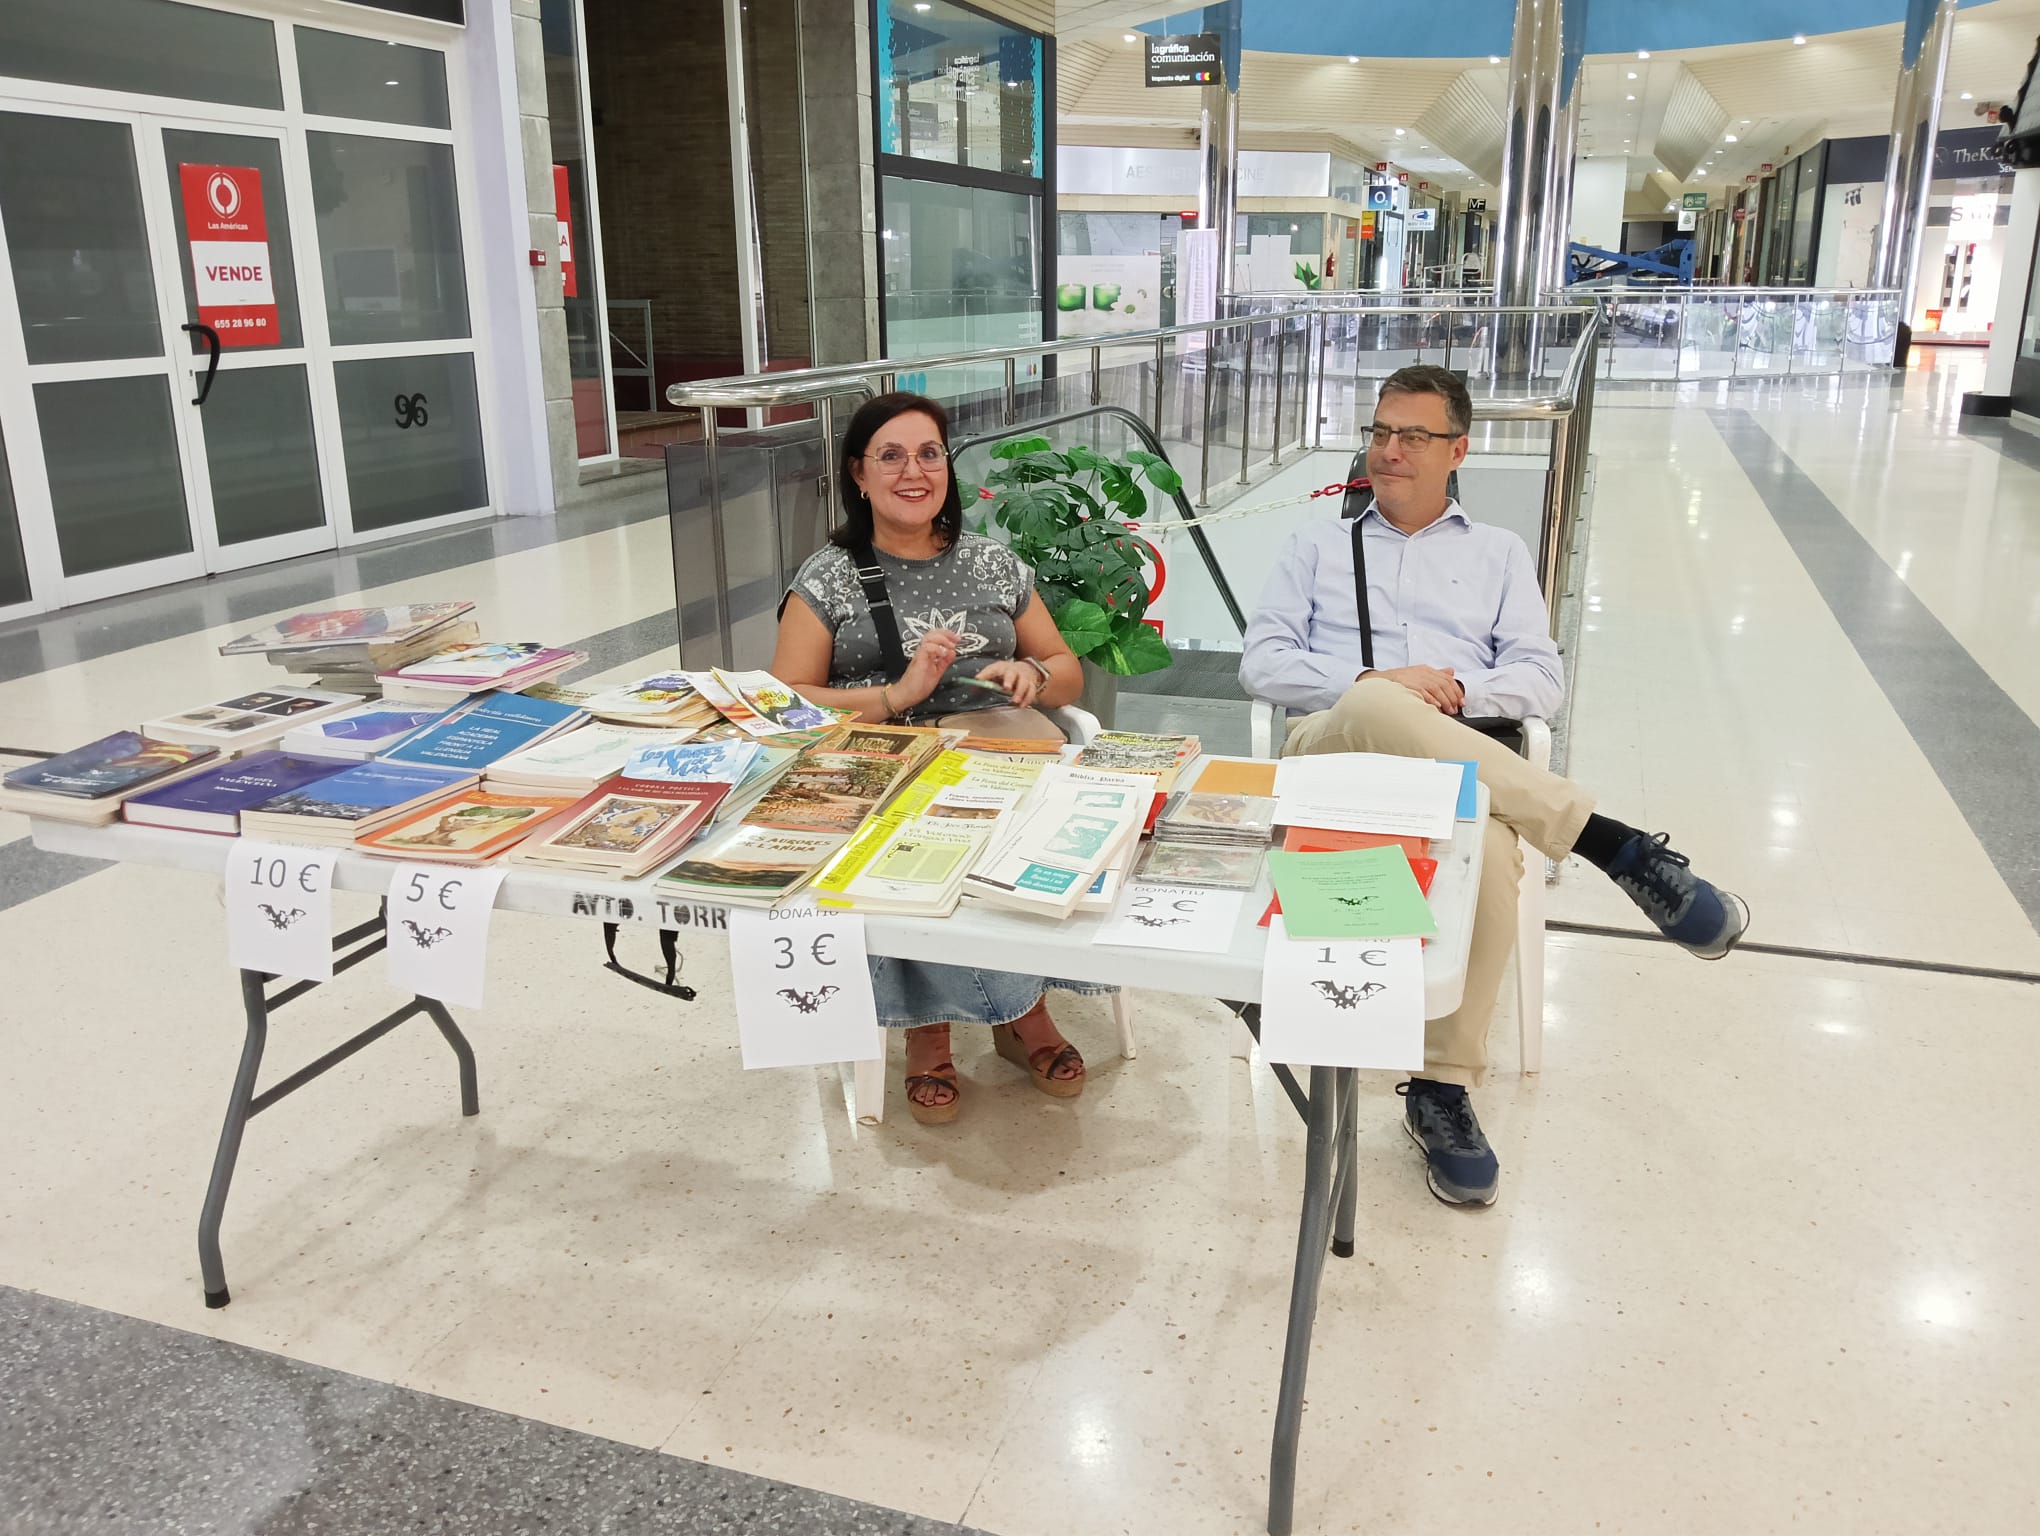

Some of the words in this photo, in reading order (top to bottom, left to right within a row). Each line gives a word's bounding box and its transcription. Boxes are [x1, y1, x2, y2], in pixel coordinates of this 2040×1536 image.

[1151, 51, 1215, 63] comunicación
[208, 222, 220, 230] Las
[205, 265, 263, 282] VENDE
[214, 319, 231, 329] 655
[232, 319, 243, 328] 28
[394, 393, 428, 429] 96
[767, 836, 833, 846] AURORES
[250, 856, 287, 889] 10
[298, 863, 321, 893] €
[406, 872, 430, 902] 5
[438, 880, 463, 911] €
[1134, 886, 1205, 896] DONATIU
[1131, 896, 1154, 909] 2
[1172, 899, 1198, 912] €
[774, 936, 795, 969] 3
[810, 933, 837, 966] €
[1317, 946, 1337, 964] 1
[1358, 949, 1388, 967] €
